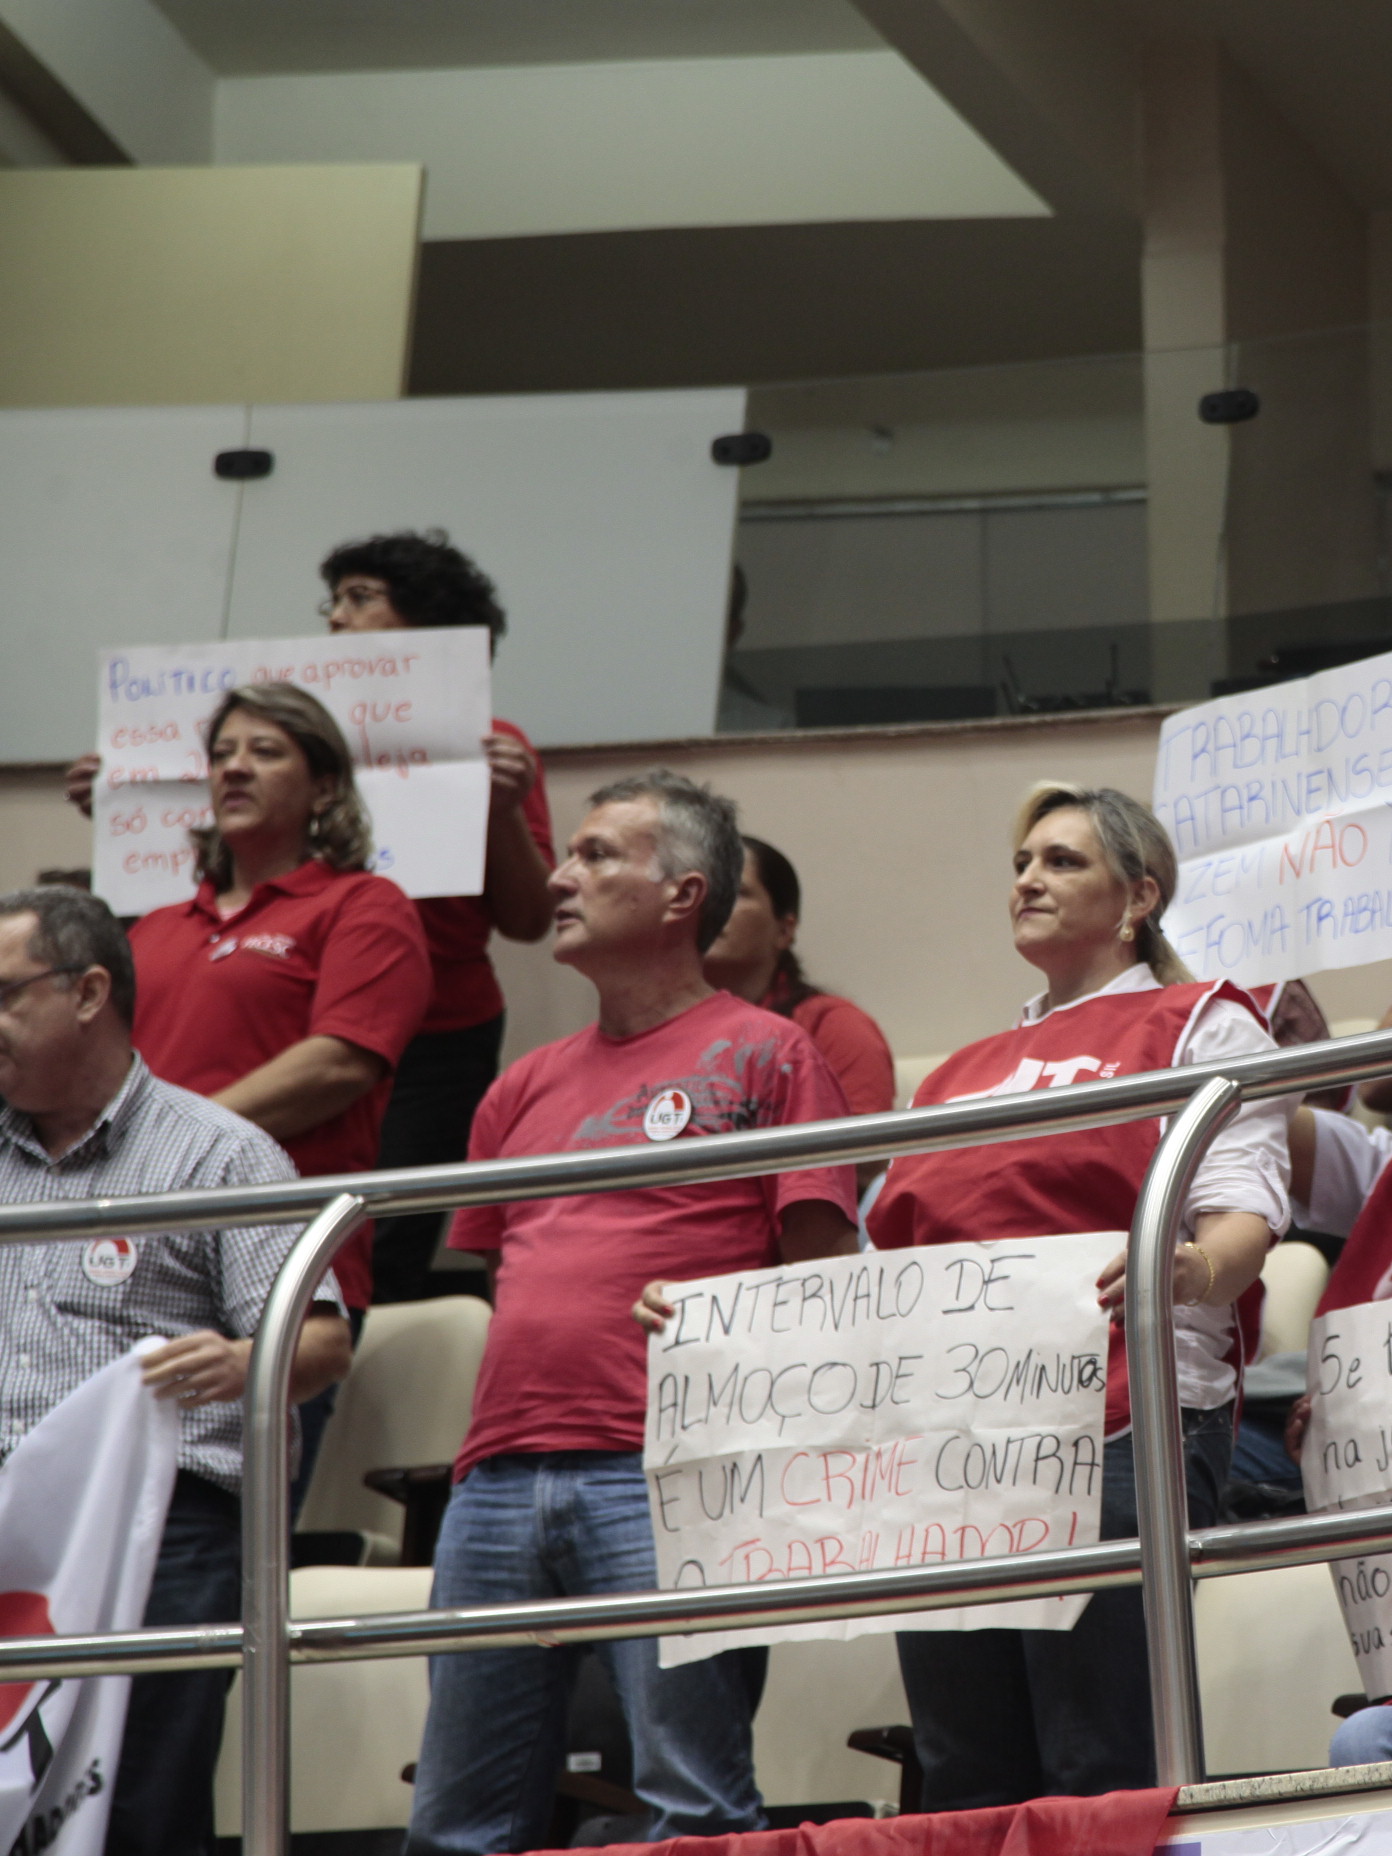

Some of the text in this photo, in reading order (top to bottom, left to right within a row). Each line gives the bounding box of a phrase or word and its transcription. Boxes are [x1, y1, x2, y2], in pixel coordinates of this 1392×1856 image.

[302, 653, 420, 690] aprovar
[1182, 848, 1267, 905] ZEM
[1279, 807, 1369, 886] NÃO
[651, 1111, 684, 1125] UGT
[662, 1255, 1036, 1352] INTERVALO DE
[655, 1361, 858, 1442] ALMOÇO
[859, 1355, 924, 1411] DE
[936, 1344, 1009, 1400] 30
[1319, 1334, 1363, 1396] Se
[654, 1447, 685, 1532] É
[699, 1452, 765, 1521] UM
[936, 1433, 1101, 1497] CONTRA
[1322, 1436, 1363, 1475] na
[1339, 1562, 1390, 1608] não
